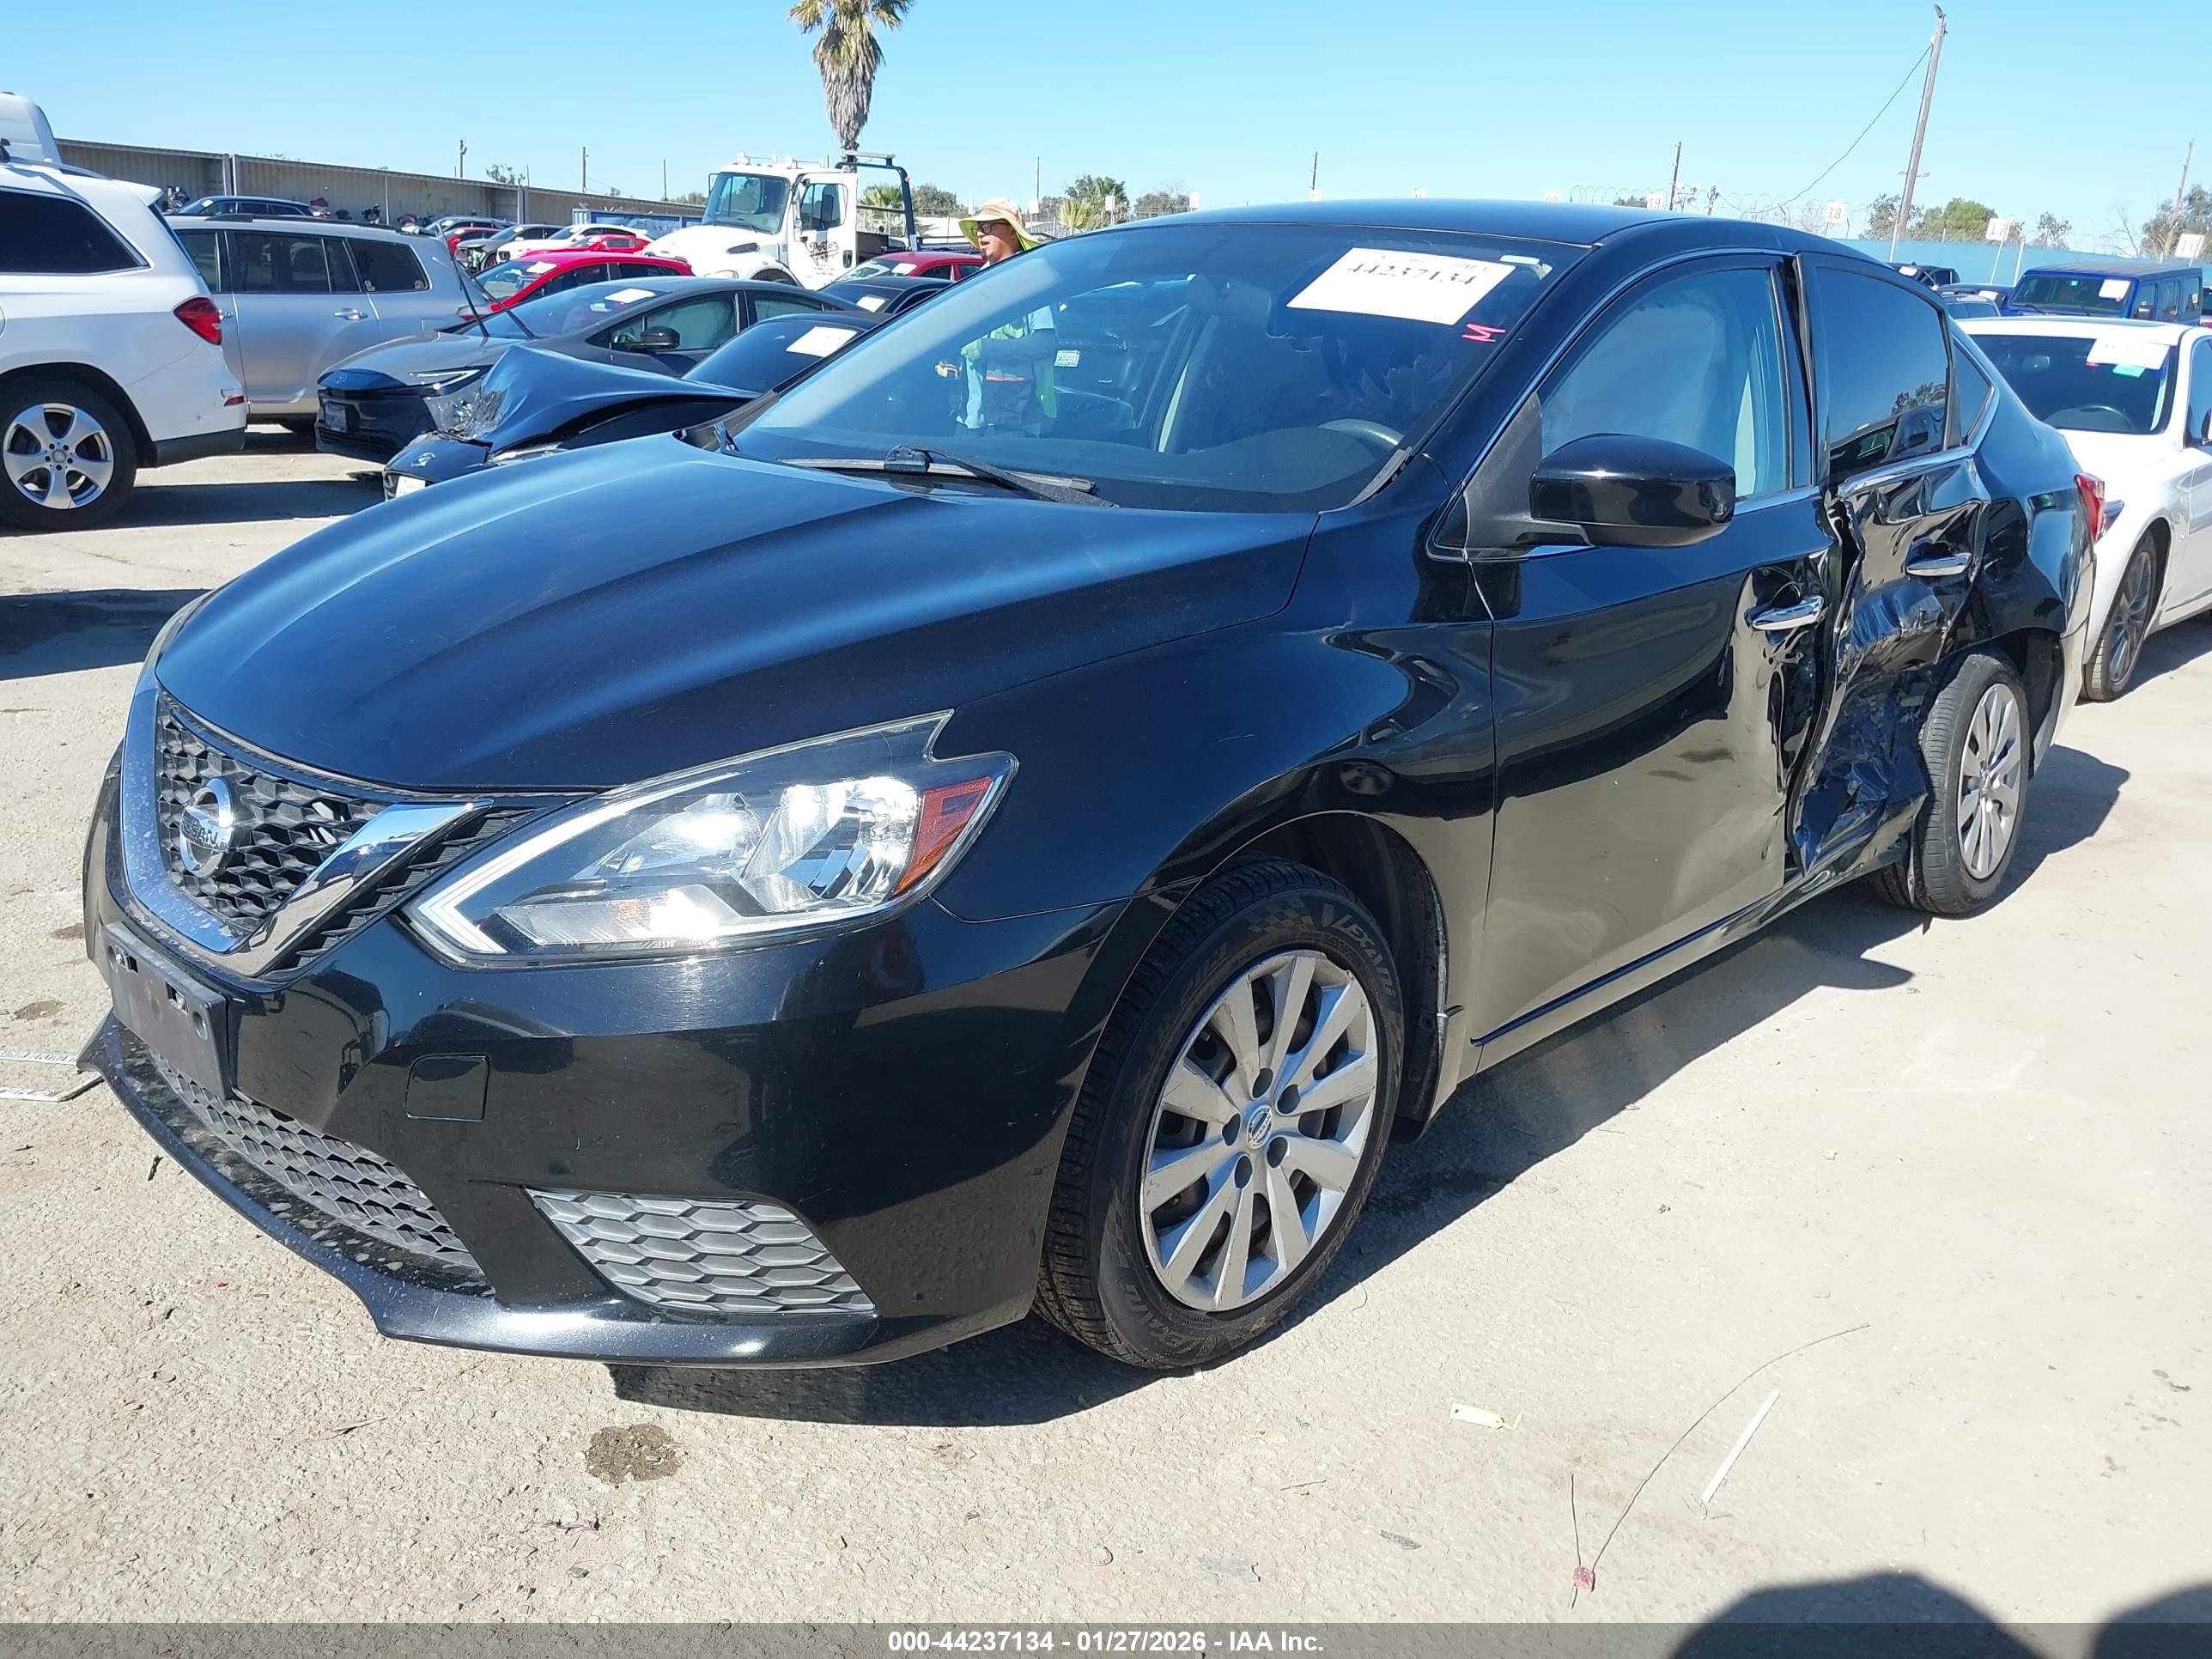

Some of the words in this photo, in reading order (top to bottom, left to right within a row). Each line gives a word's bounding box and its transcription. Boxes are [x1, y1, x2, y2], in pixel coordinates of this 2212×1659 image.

[1828, 207, 1842, 220] 18
[1990, 223, 2008, 235] 17
[1253, 1113, 1272, 1142] NISSAN
